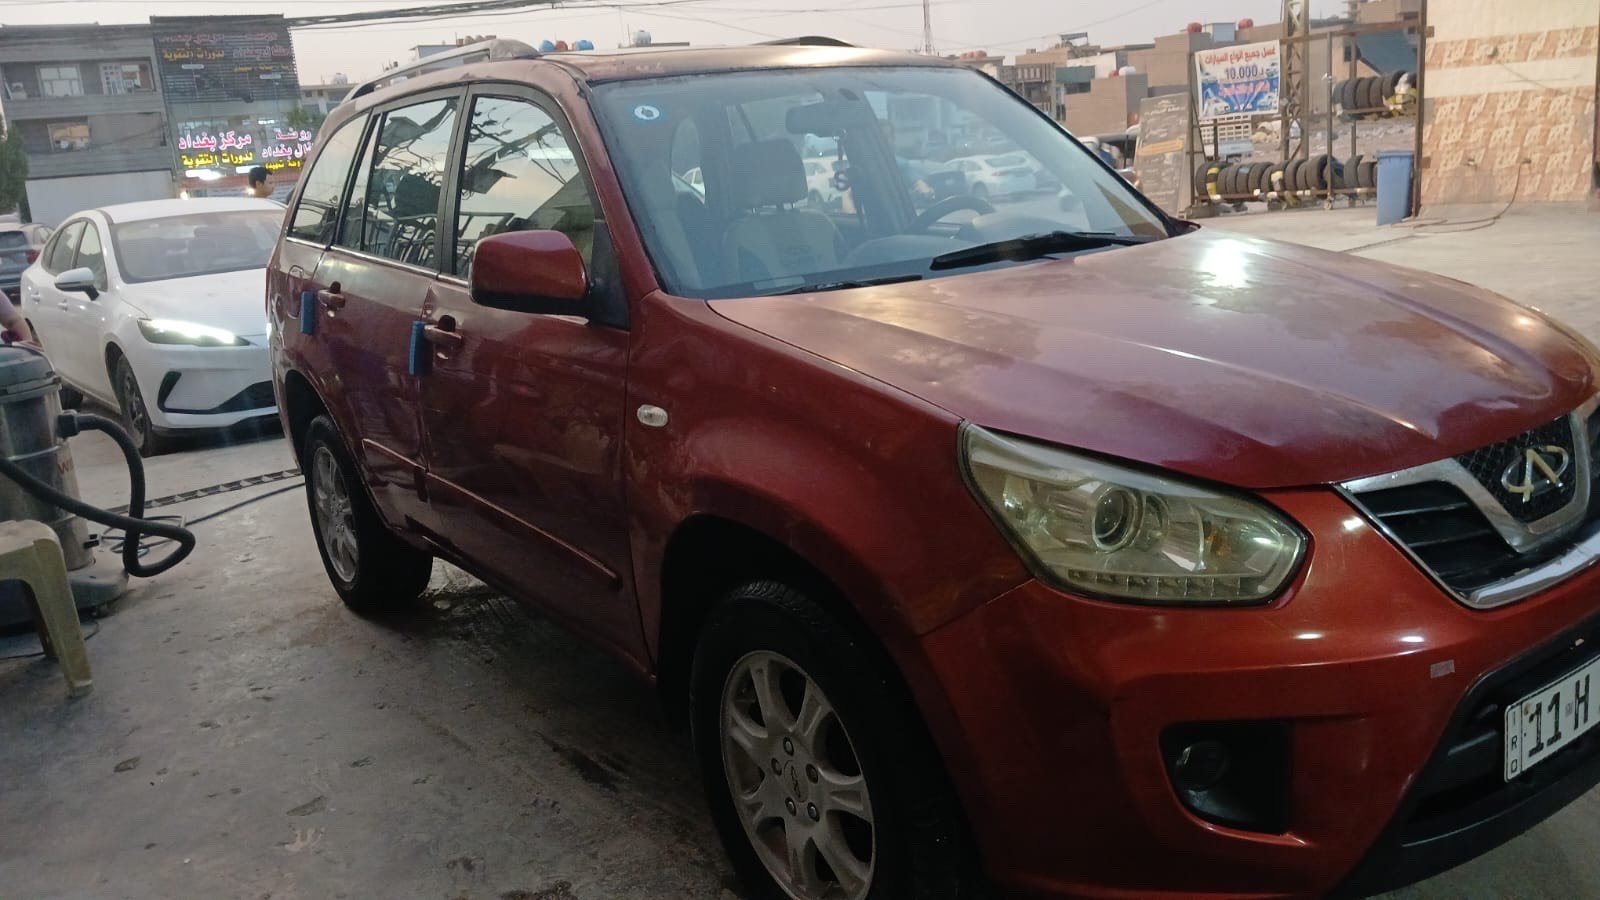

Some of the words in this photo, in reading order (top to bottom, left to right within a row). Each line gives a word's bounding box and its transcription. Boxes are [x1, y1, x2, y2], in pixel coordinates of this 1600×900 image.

[1225, 65, 1258, 80] 10.000
[178, 132, 217, 152] بغداد
[218, 130, 252, 151] مركز
[221, 150, 254, 165] لدورات
[261, 143, 293, 160] بغداد
[181, 152, 220, 169] التقوية
[1528, 691, 1562, 757] 11
[1573, 673, 1590, 731] H
